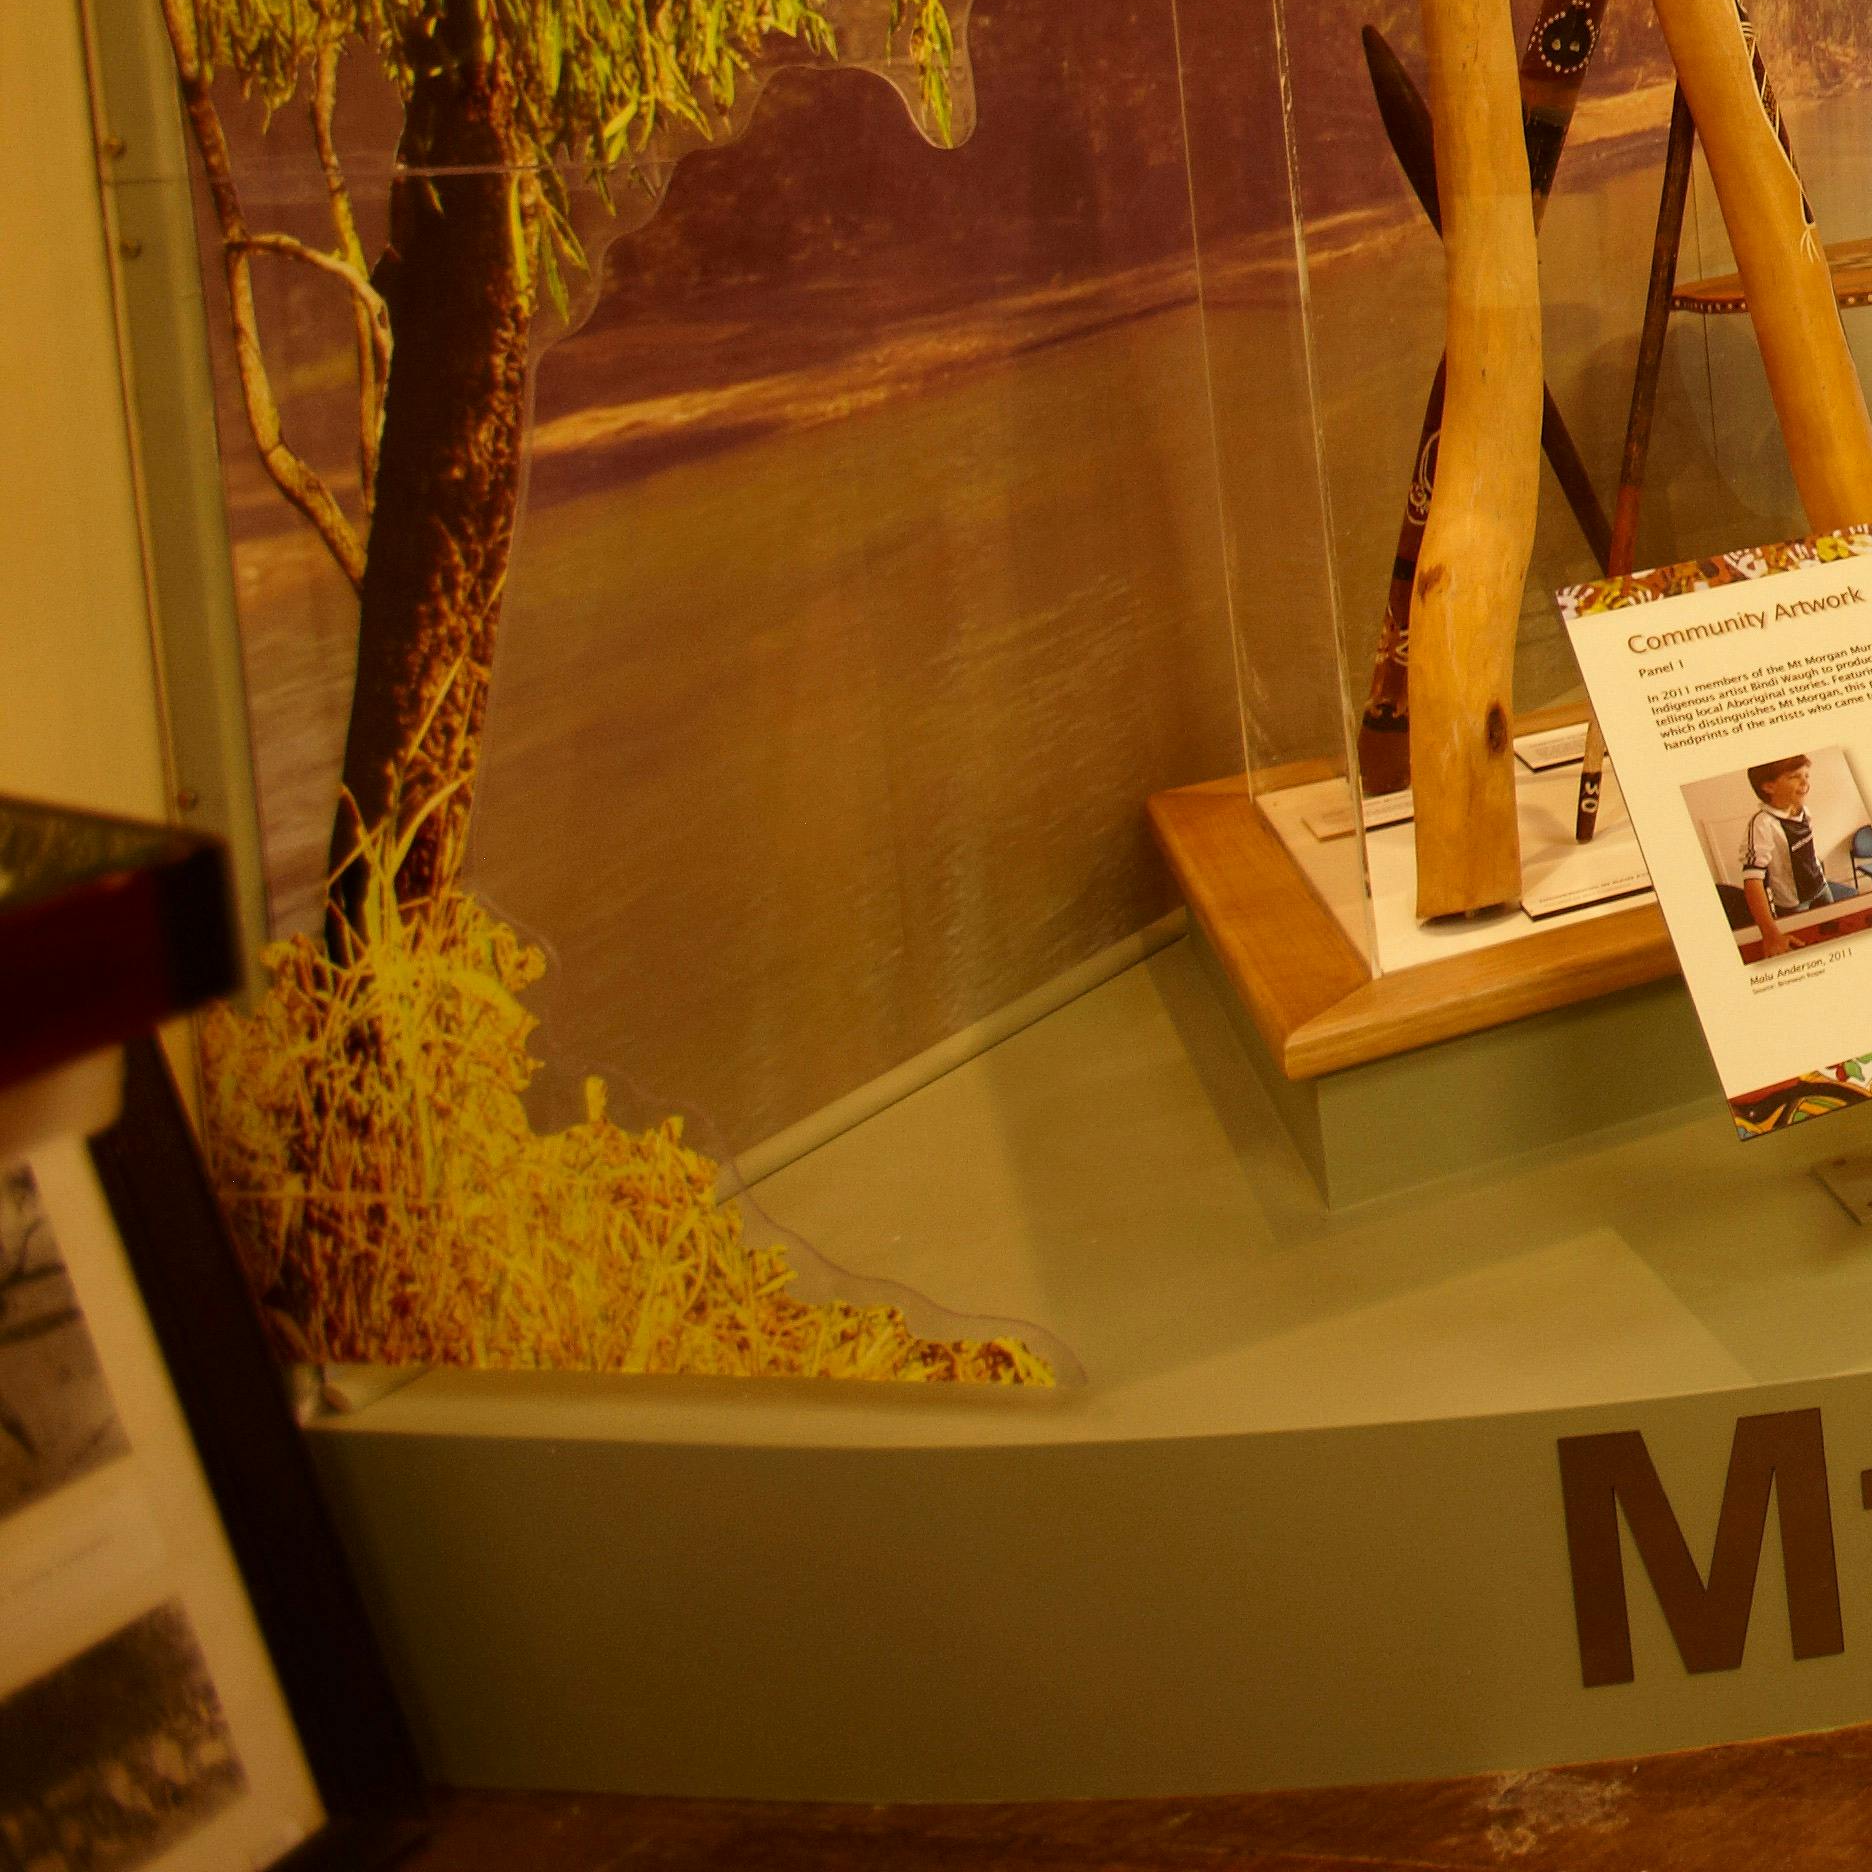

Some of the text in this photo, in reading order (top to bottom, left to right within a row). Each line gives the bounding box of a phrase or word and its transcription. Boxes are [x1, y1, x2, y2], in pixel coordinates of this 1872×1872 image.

[1628, 586, 1865, 654] Community Artwork
[1639, 661, 1674, 679] Panel
[1663, 686, 1689, 700] 2011
[1695, 674, 1749, 692] members
[1752, 667, 1763, 678] of
[1766, 665, 1784, 675] the
[1787, 660, 1802, 670] Mt
[1804, 650, 1848, 667] Morgan
[1777, 959, 1826, 977] Anderson,
[1829, 947, 1852, 962] 2011
